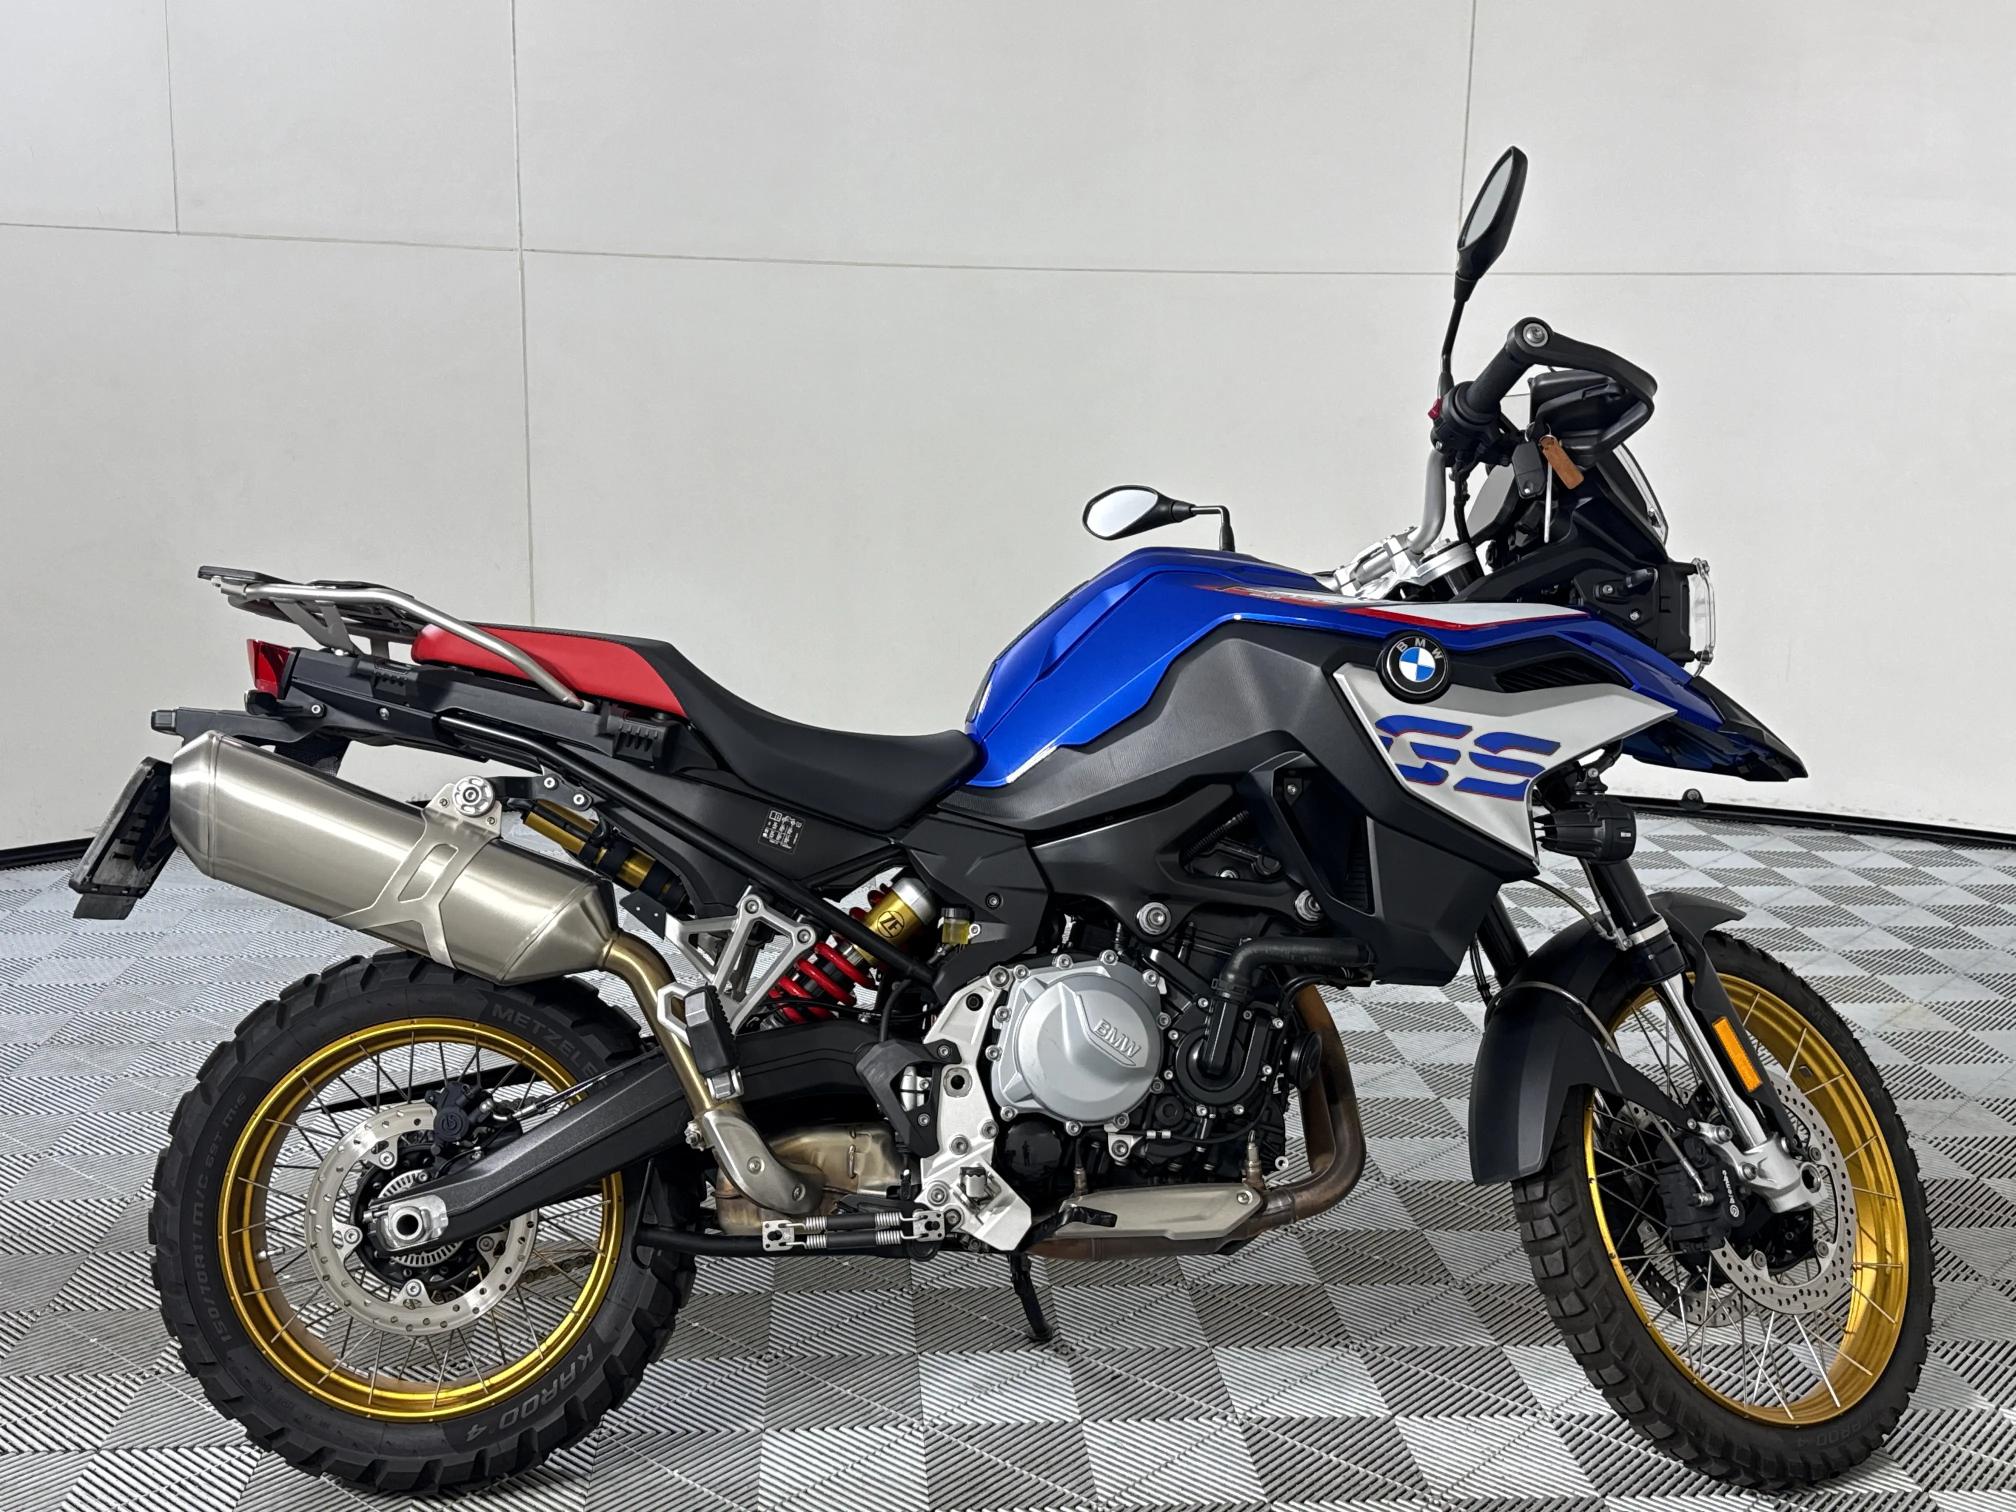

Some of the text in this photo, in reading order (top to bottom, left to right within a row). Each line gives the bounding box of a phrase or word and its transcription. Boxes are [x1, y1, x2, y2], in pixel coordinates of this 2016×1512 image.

[1396, 638, 1443, 659] BMW
[1374, 714, 1561, 801] GS
[878, 911, 904, 938] ZF
[491, 1003, 607, 1088] METZELE
[1093, 1018, 1142, 1059] BMW
[193, 1232, 232, 1343] 150/70R17
[466, 1343, 594, 1442] KAROO 4
